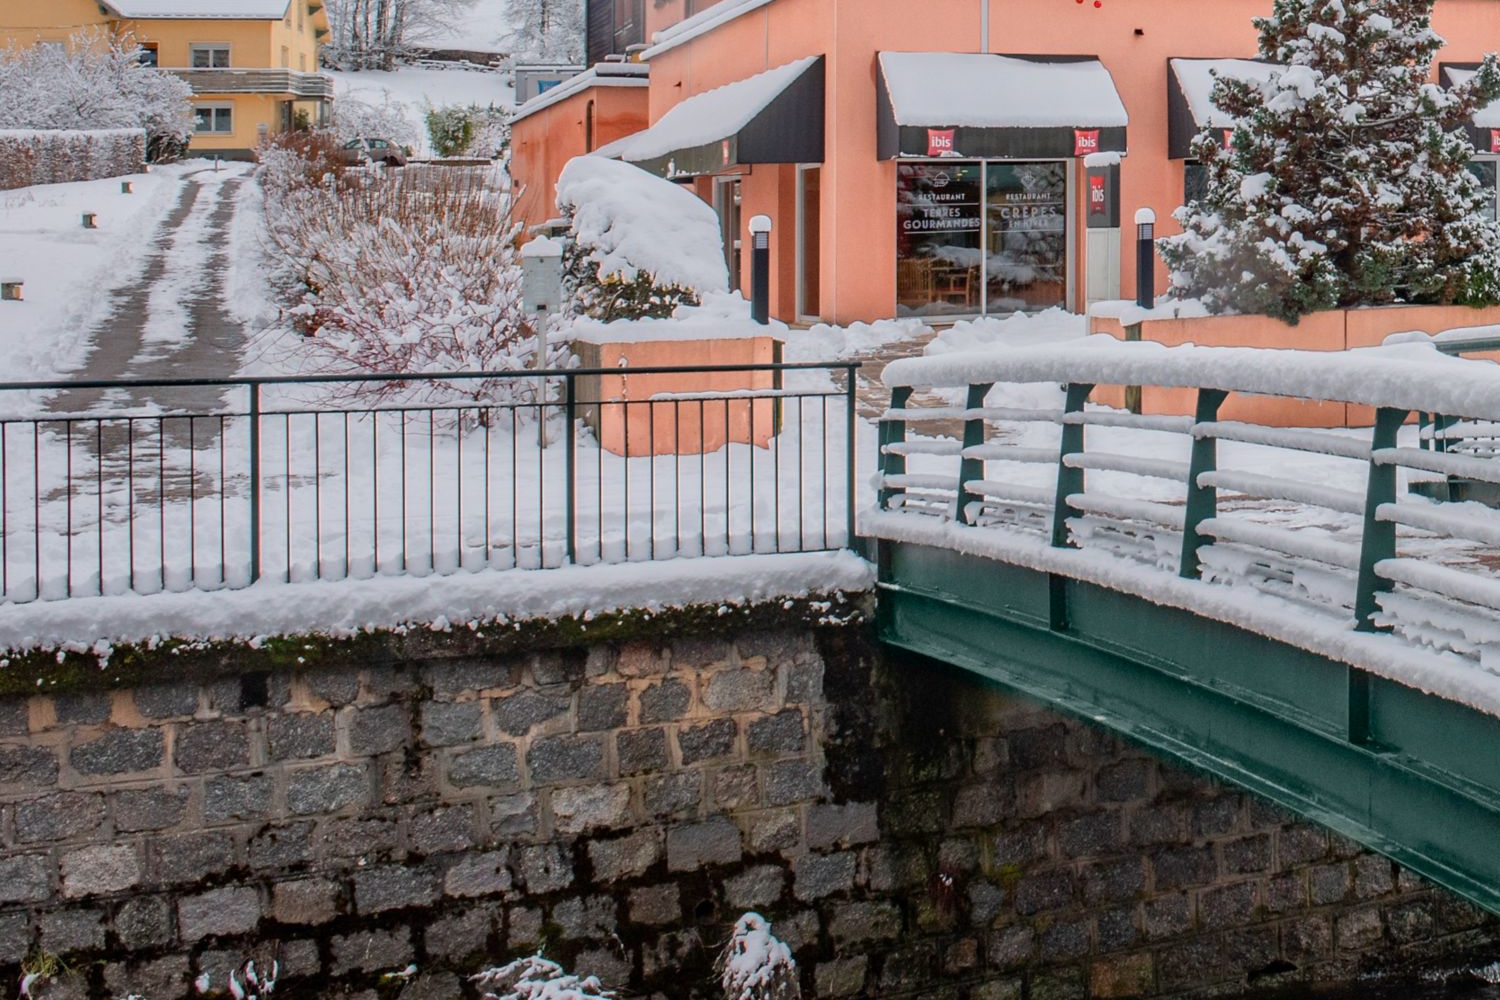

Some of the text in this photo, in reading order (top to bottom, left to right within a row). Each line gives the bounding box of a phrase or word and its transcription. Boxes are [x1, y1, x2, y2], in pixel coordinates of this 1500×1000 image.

[931, 135, 951, 148] ibis
[1078, 135, 1096, 148] ibis
[918, 192, 966, 201] RESTAURANT
[1005, 192, 1051, 200] RESTAURANT
[1092, 184, 1104, 202] ibis
[923, 207, 961, 218] TERRES
[903, 218, 981, 230] GOURMANDES
